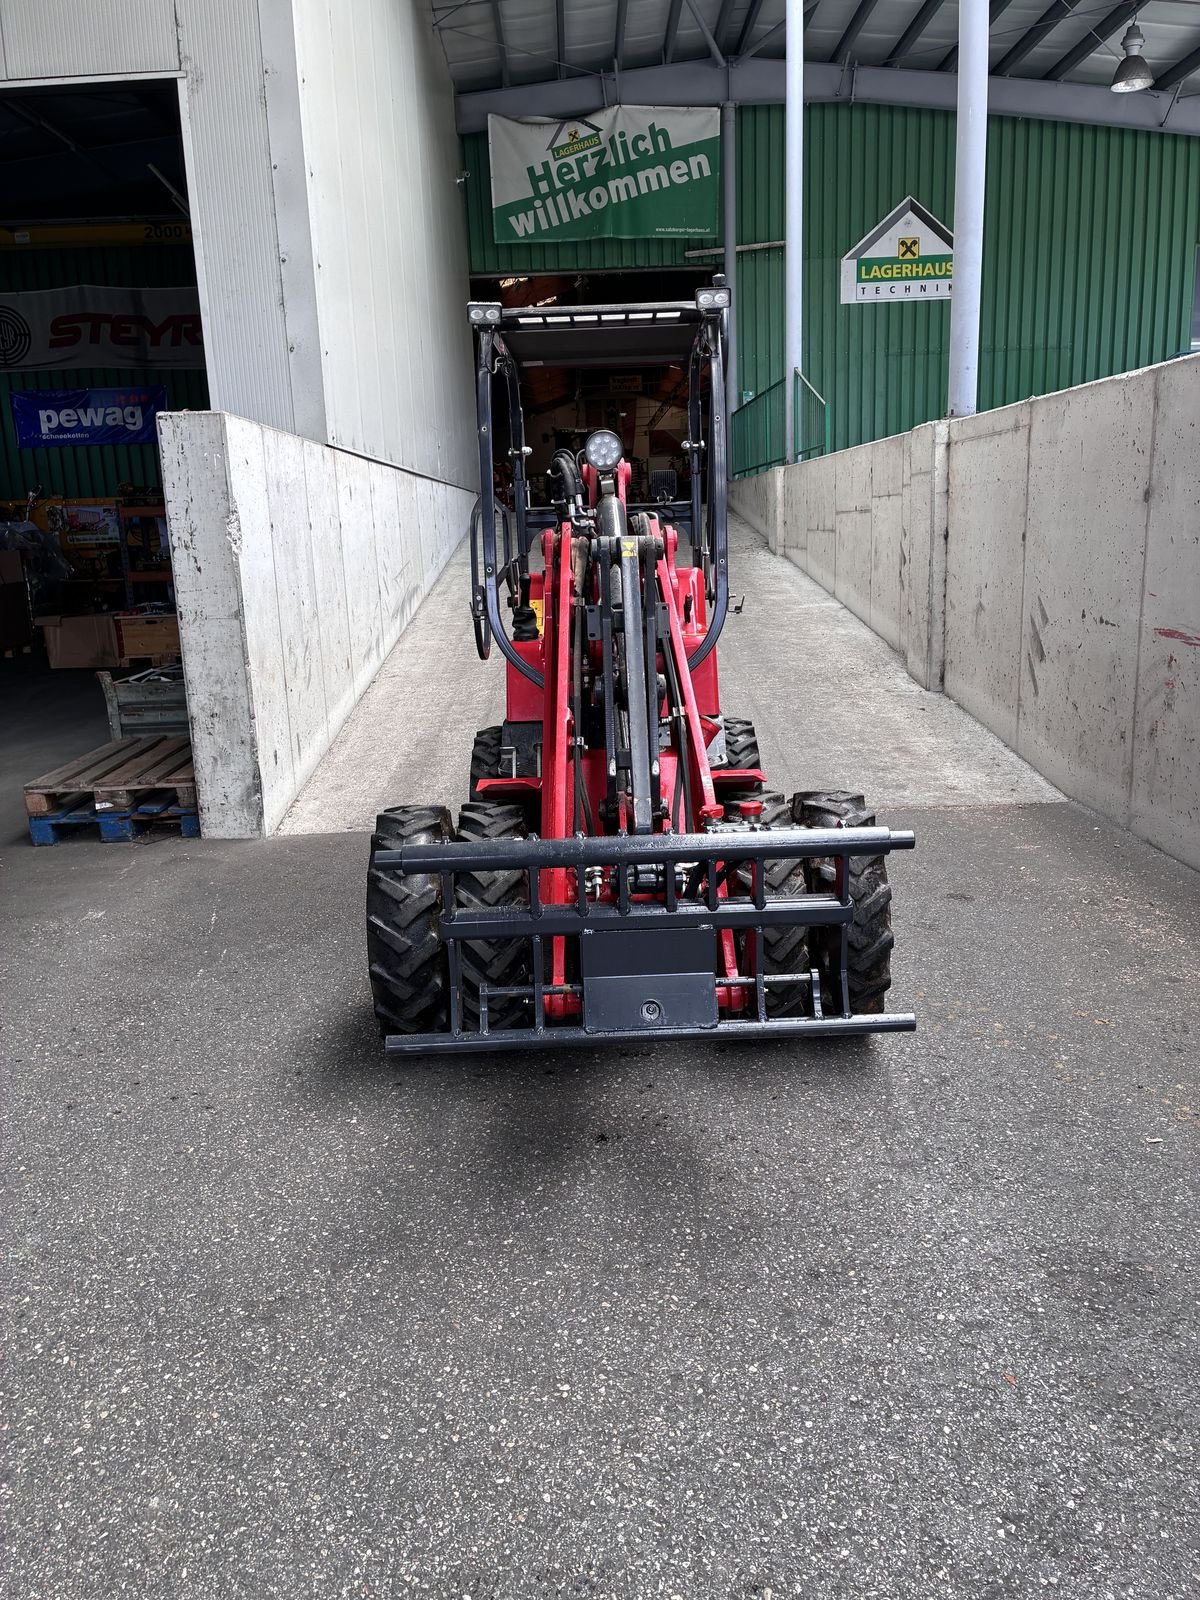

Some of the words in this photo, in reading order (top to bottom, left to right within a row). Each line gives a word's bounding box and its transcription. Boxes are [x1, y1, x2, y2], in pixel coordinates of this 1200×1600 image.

[526, 122, 673, 197] Herzlich
[554, 136, 600, 159] LAGERHAUS
[508, 153, 712, 238] willkommen
[143, 225, 182, 239] 2000
[861, 262, 953, 279] LAGERHAUS
[49, 313, 203, 349] STEYR
[38, 405, 144, 434] pewag
